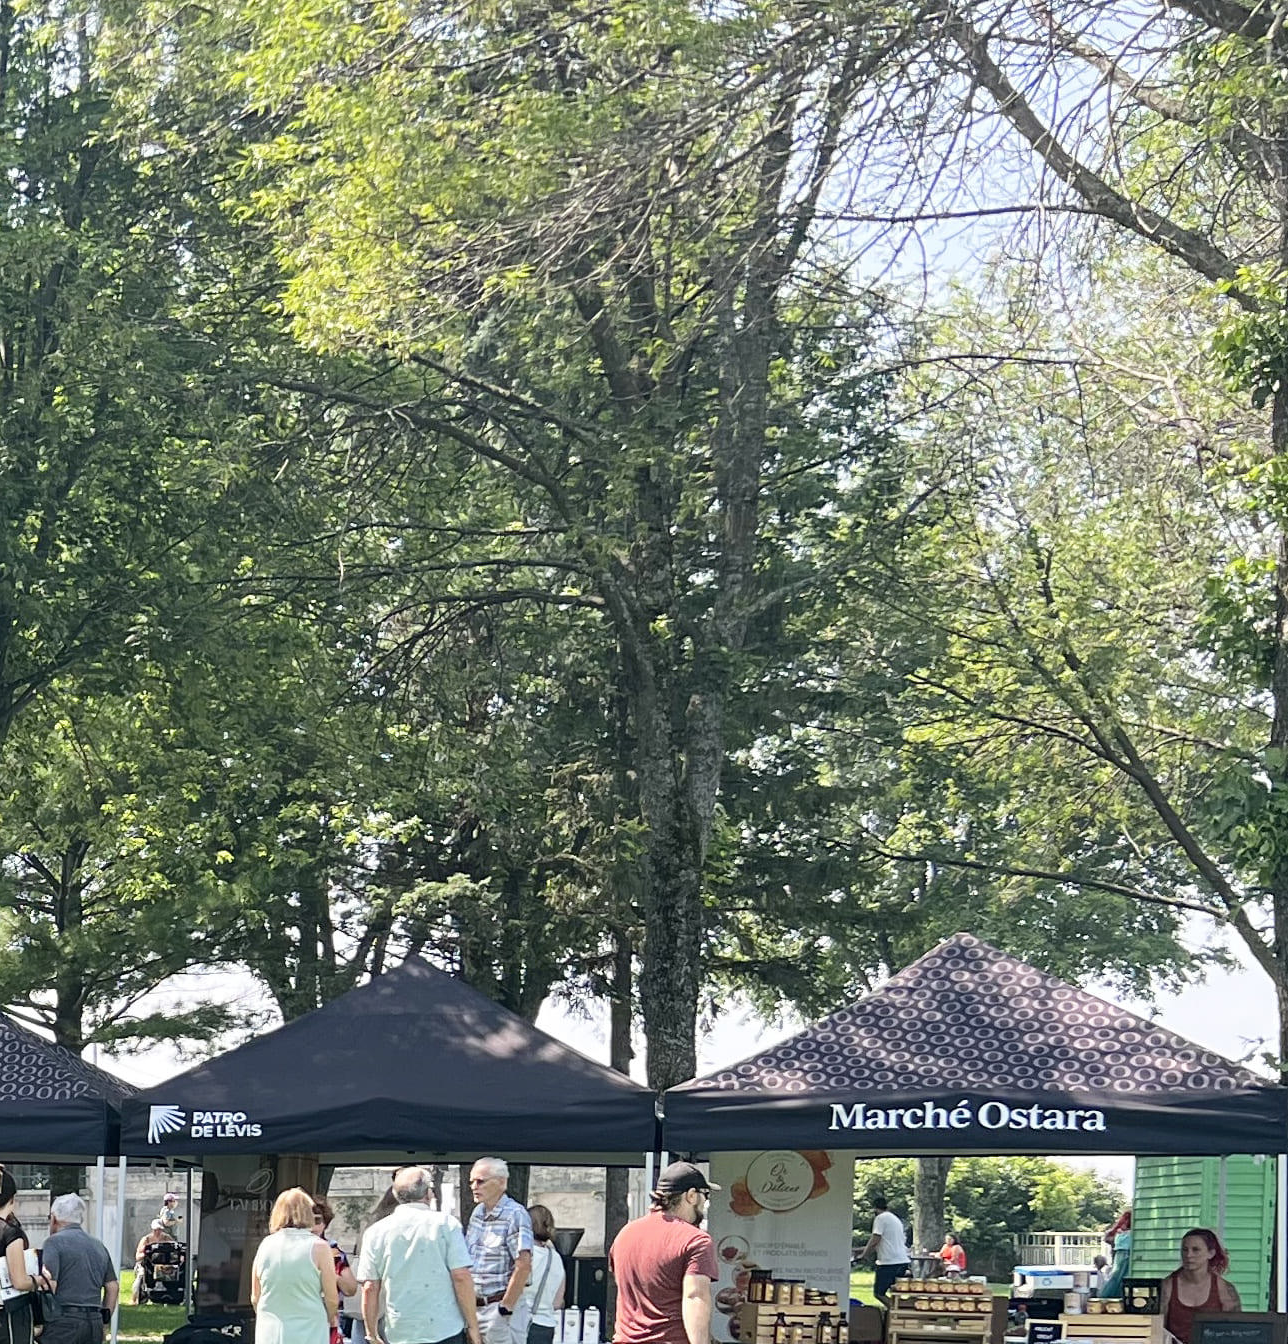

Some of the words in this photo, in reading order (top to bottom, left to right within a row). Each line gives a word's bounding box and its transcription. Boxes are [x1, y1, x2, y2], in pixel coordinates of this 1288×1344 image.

[192, 1111, 247, 1124] PATRO
[828, 1100, 972, 1130] Marché
[977, 1101, 1107, 1131] Ostara
[191, 1126, 214, 1138] DE
[216, 1121, 263, 1138] LÉVIS
